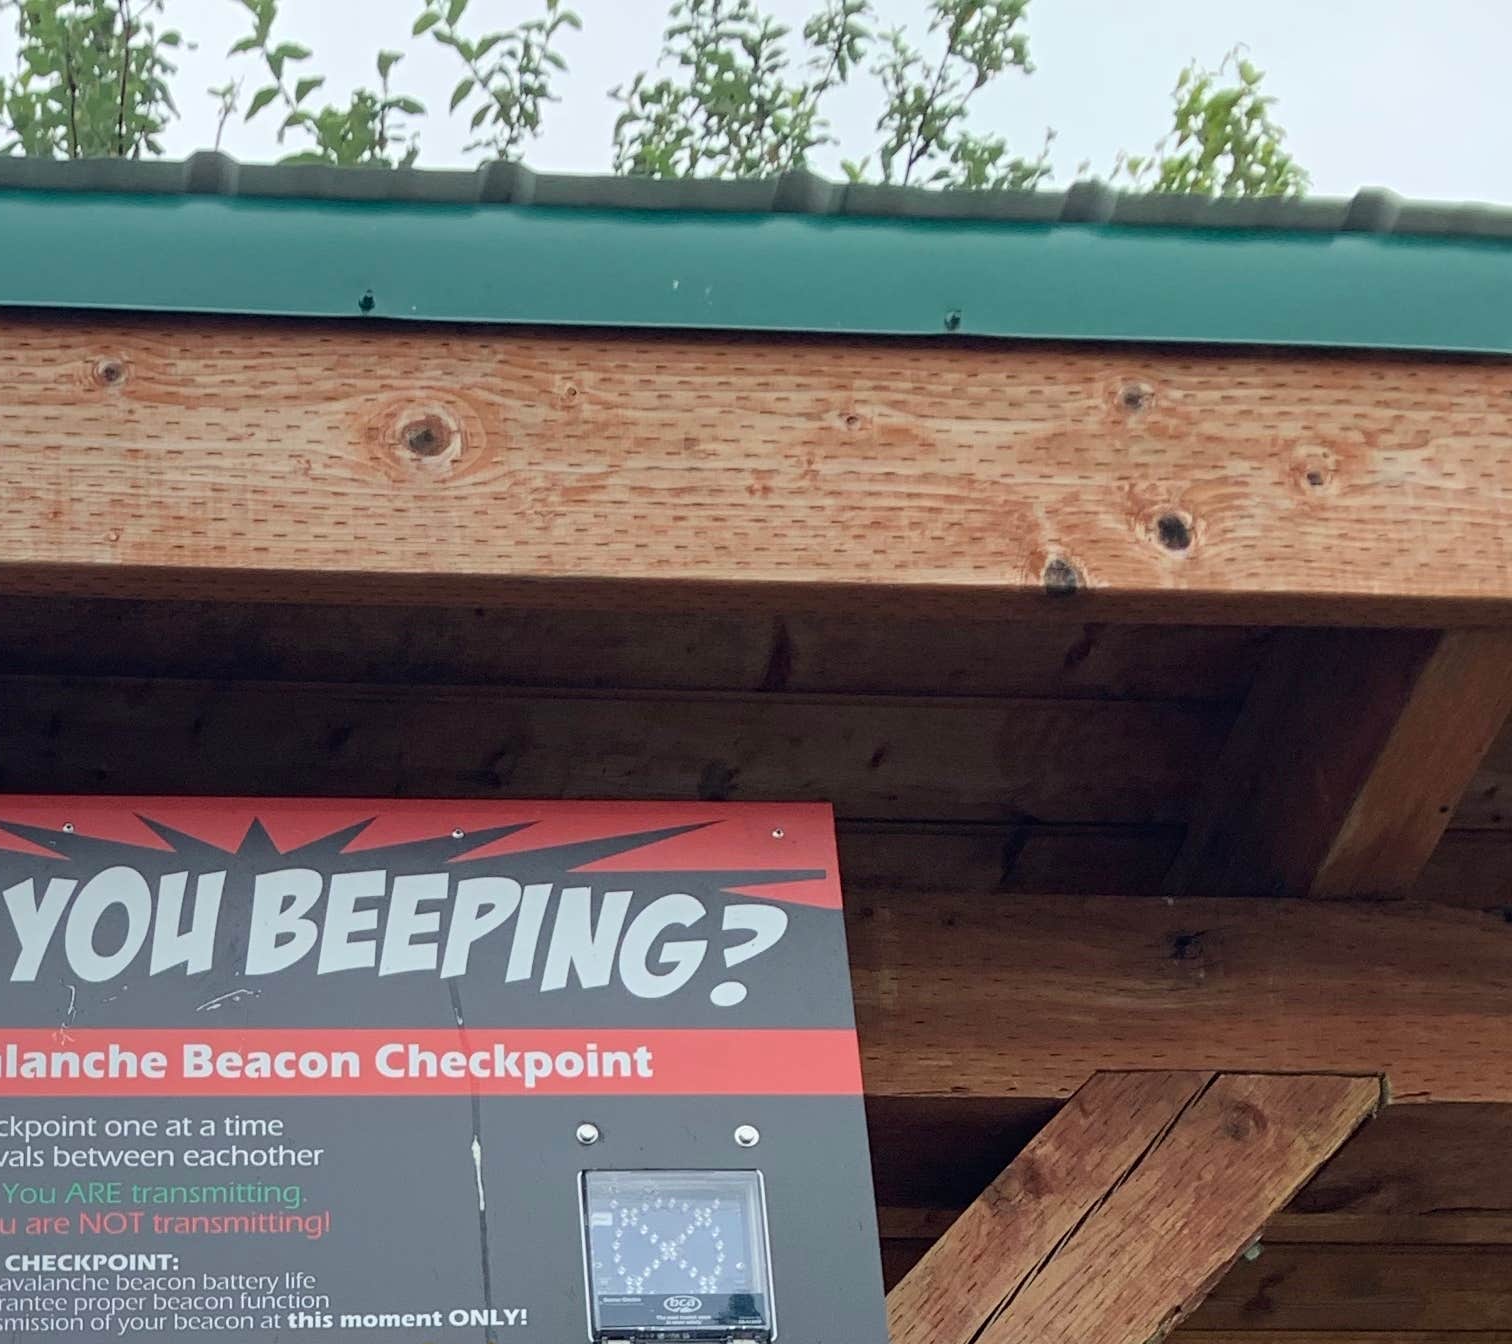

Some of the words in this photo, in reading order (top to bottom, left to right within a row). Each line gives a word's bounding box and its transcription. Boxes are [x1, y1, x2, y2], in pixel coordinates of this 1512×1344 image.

[2, 866, 227, 982] YOU
[245, 868, 788, 1007] BEEPING?
[184, 1044, 359, 1078] Beacon
[376, 1044, 653, 1088] Checkpoint
[105, 1120, 157, 1136] one
[166, 1118, 192, 1136] at
[200, 1120, 215, 1136] a
[224, 1115, 283, 1136] time
[54, 1146, 174, 1166] between
[184, 1145, 324, 1166] eachother
[5, 1254, 178, 1271] CHECKPOINT:
[0, 1274, 109, 1291] avalanche
[117, 1275, 195, 1290] beacon
[205, 1274, 279, 1294] battery
[286, 1272, 315, 1288] life
